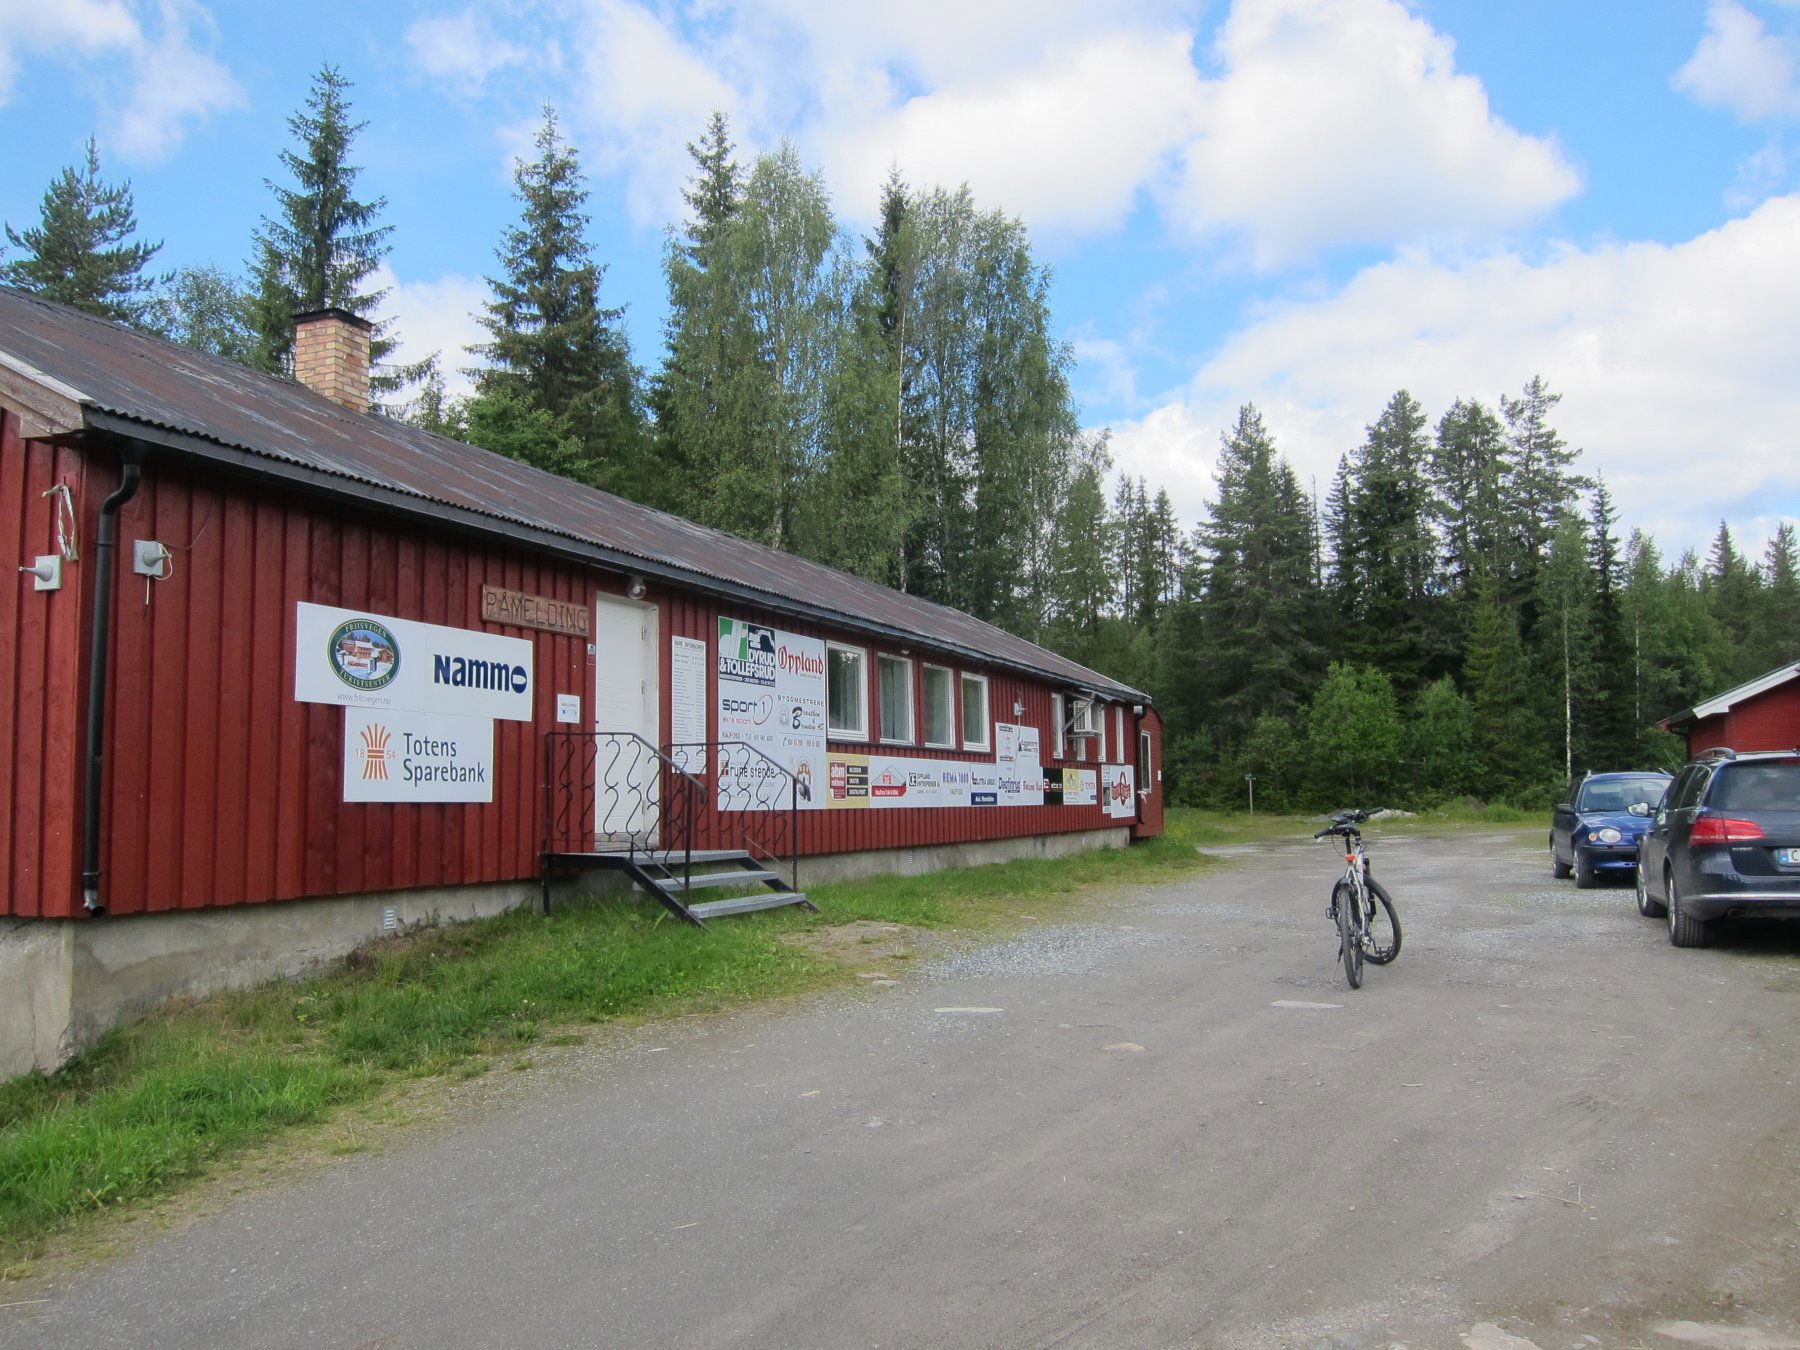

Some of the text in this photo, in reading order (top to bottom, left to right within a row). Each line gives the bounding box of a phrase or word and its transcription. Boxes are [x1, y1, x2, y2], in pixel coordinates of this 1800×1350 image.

[486, 591, 587, 632] PÅMELDING
[345, 621, 387, 638] FRIISVEGEN
[748, 648, 776, 667] DYRUD
[778, 645, 824, 675] Oppland
[340, 669, 391, 688] TURISTSENTER
[432, 654, 528, 694] Nammo
[336, 693, 391, 705] www.friisvegen.no
[722, 699, 758, 714] sport
[777, 694, 825, 706] BYGGMESTRENE
[355, 748, 396, 760] 18 54
[403, 733, 457, 758] Totens
[403, 758, 485, 787] Sparebank
[942, 772, 957, 784] REMA
